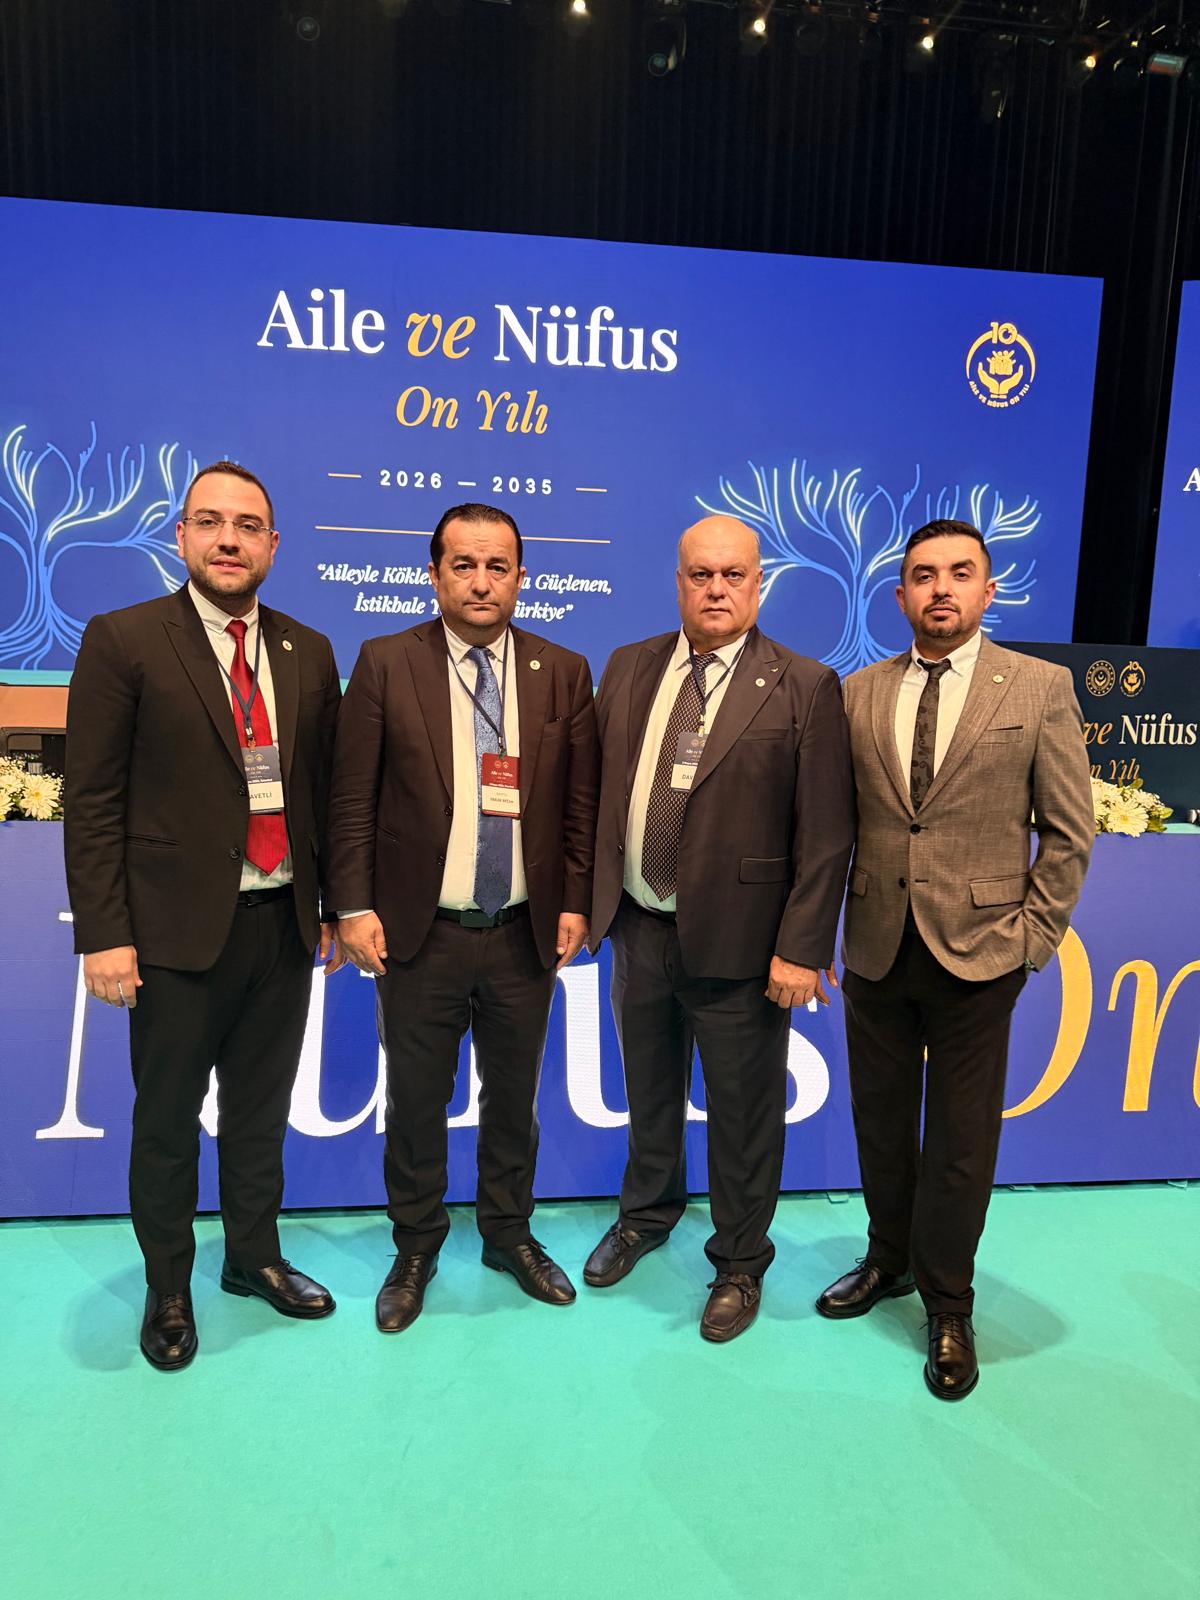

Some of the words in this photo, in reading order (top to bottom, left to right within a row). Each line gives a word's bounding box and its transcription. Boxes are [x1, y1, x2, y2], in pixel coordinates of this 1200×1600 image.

[256, 288, 385, 354] Aile
[405, 312, 476, 359] ve
[493, 304, 678, 372] Nüfus
[396, 386, 459, 429] On
[476, 389, 549, 434] Yılı
[379, 469, 442, 489] 2026
[492, 476, 552, 495] 2035
[535, 573, 612, 595] Güçlenen,
[354, 591, 426, 614] İstikbale
[514, 600, 574, 623] ürkiye”
[1118, 712, 1198, 746] Nüfus
